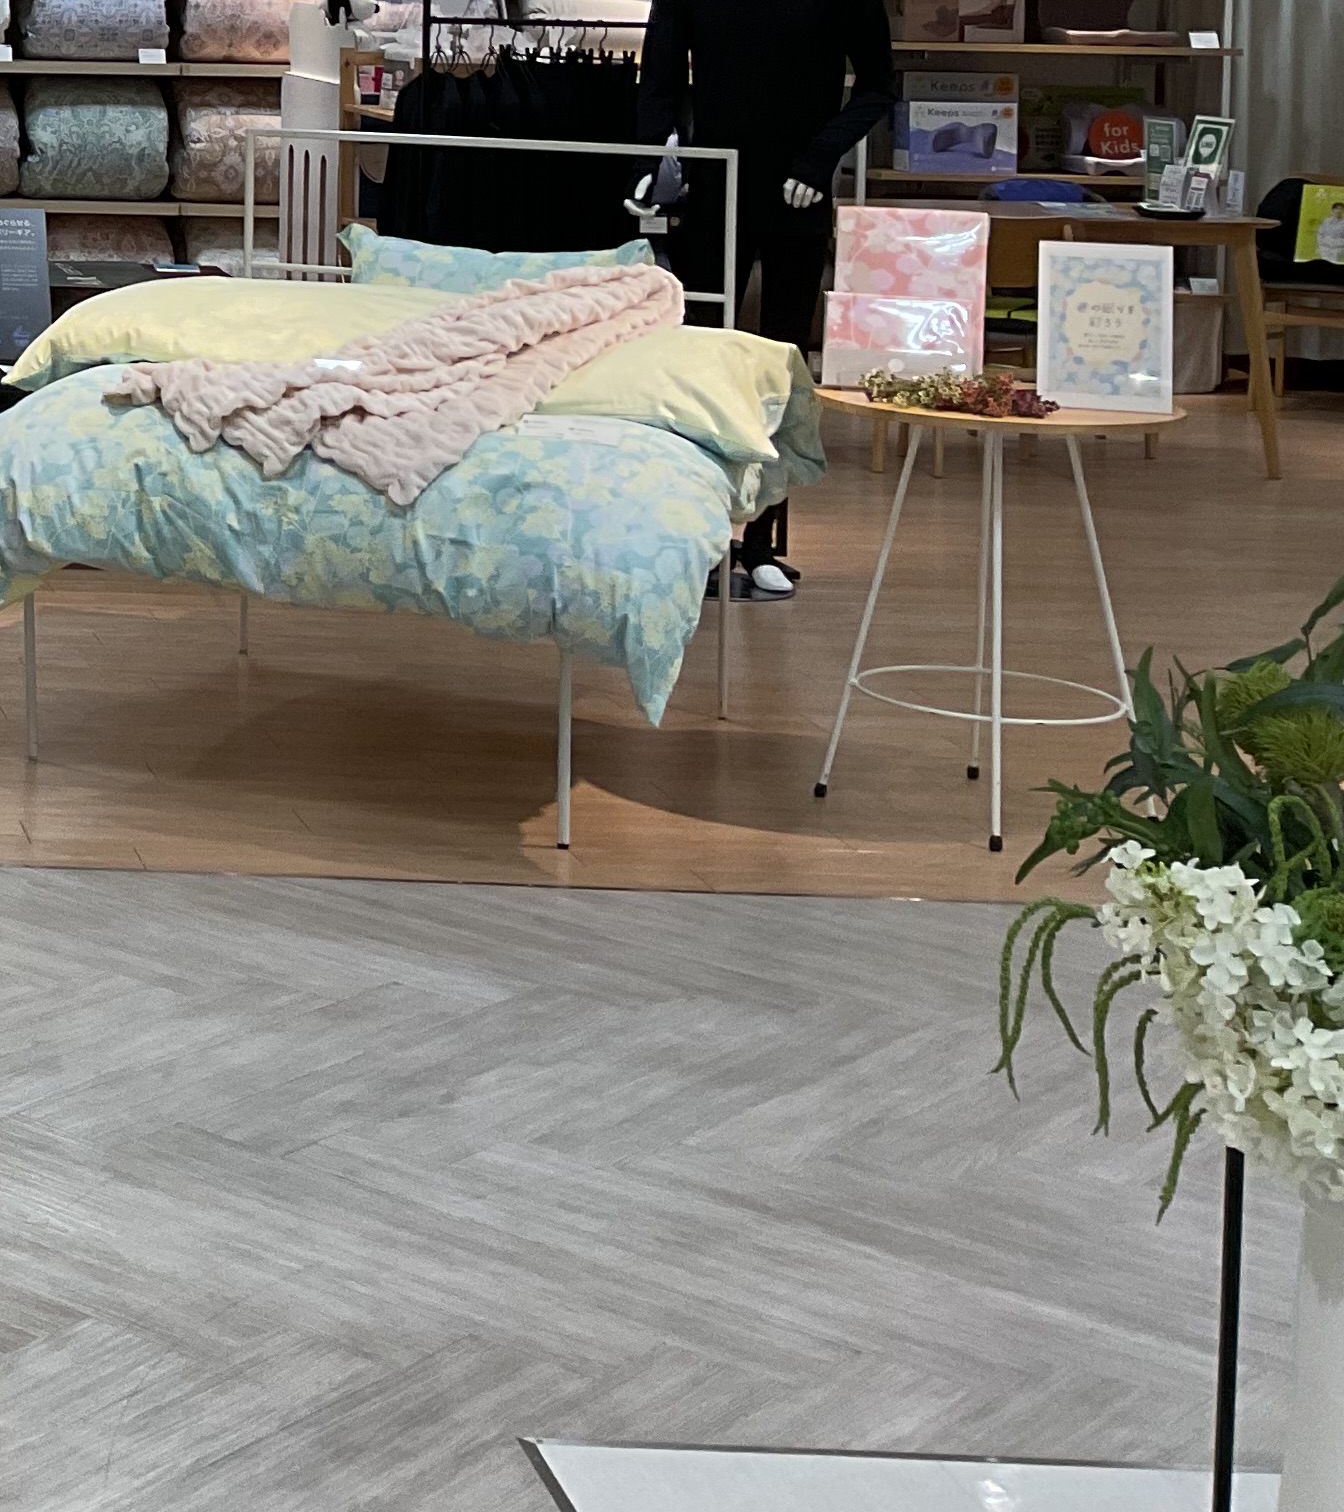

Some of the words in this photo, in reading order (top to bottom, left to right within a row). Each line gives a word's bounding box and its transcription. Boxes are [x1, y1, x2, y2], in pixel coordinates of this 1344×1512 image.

[931, 79, 976, 93] Keeps
[927, 108, 960, 118] Keeps
[1103, 122, 1129, 137] for
[1099, 139, 1140, 155] Kids
